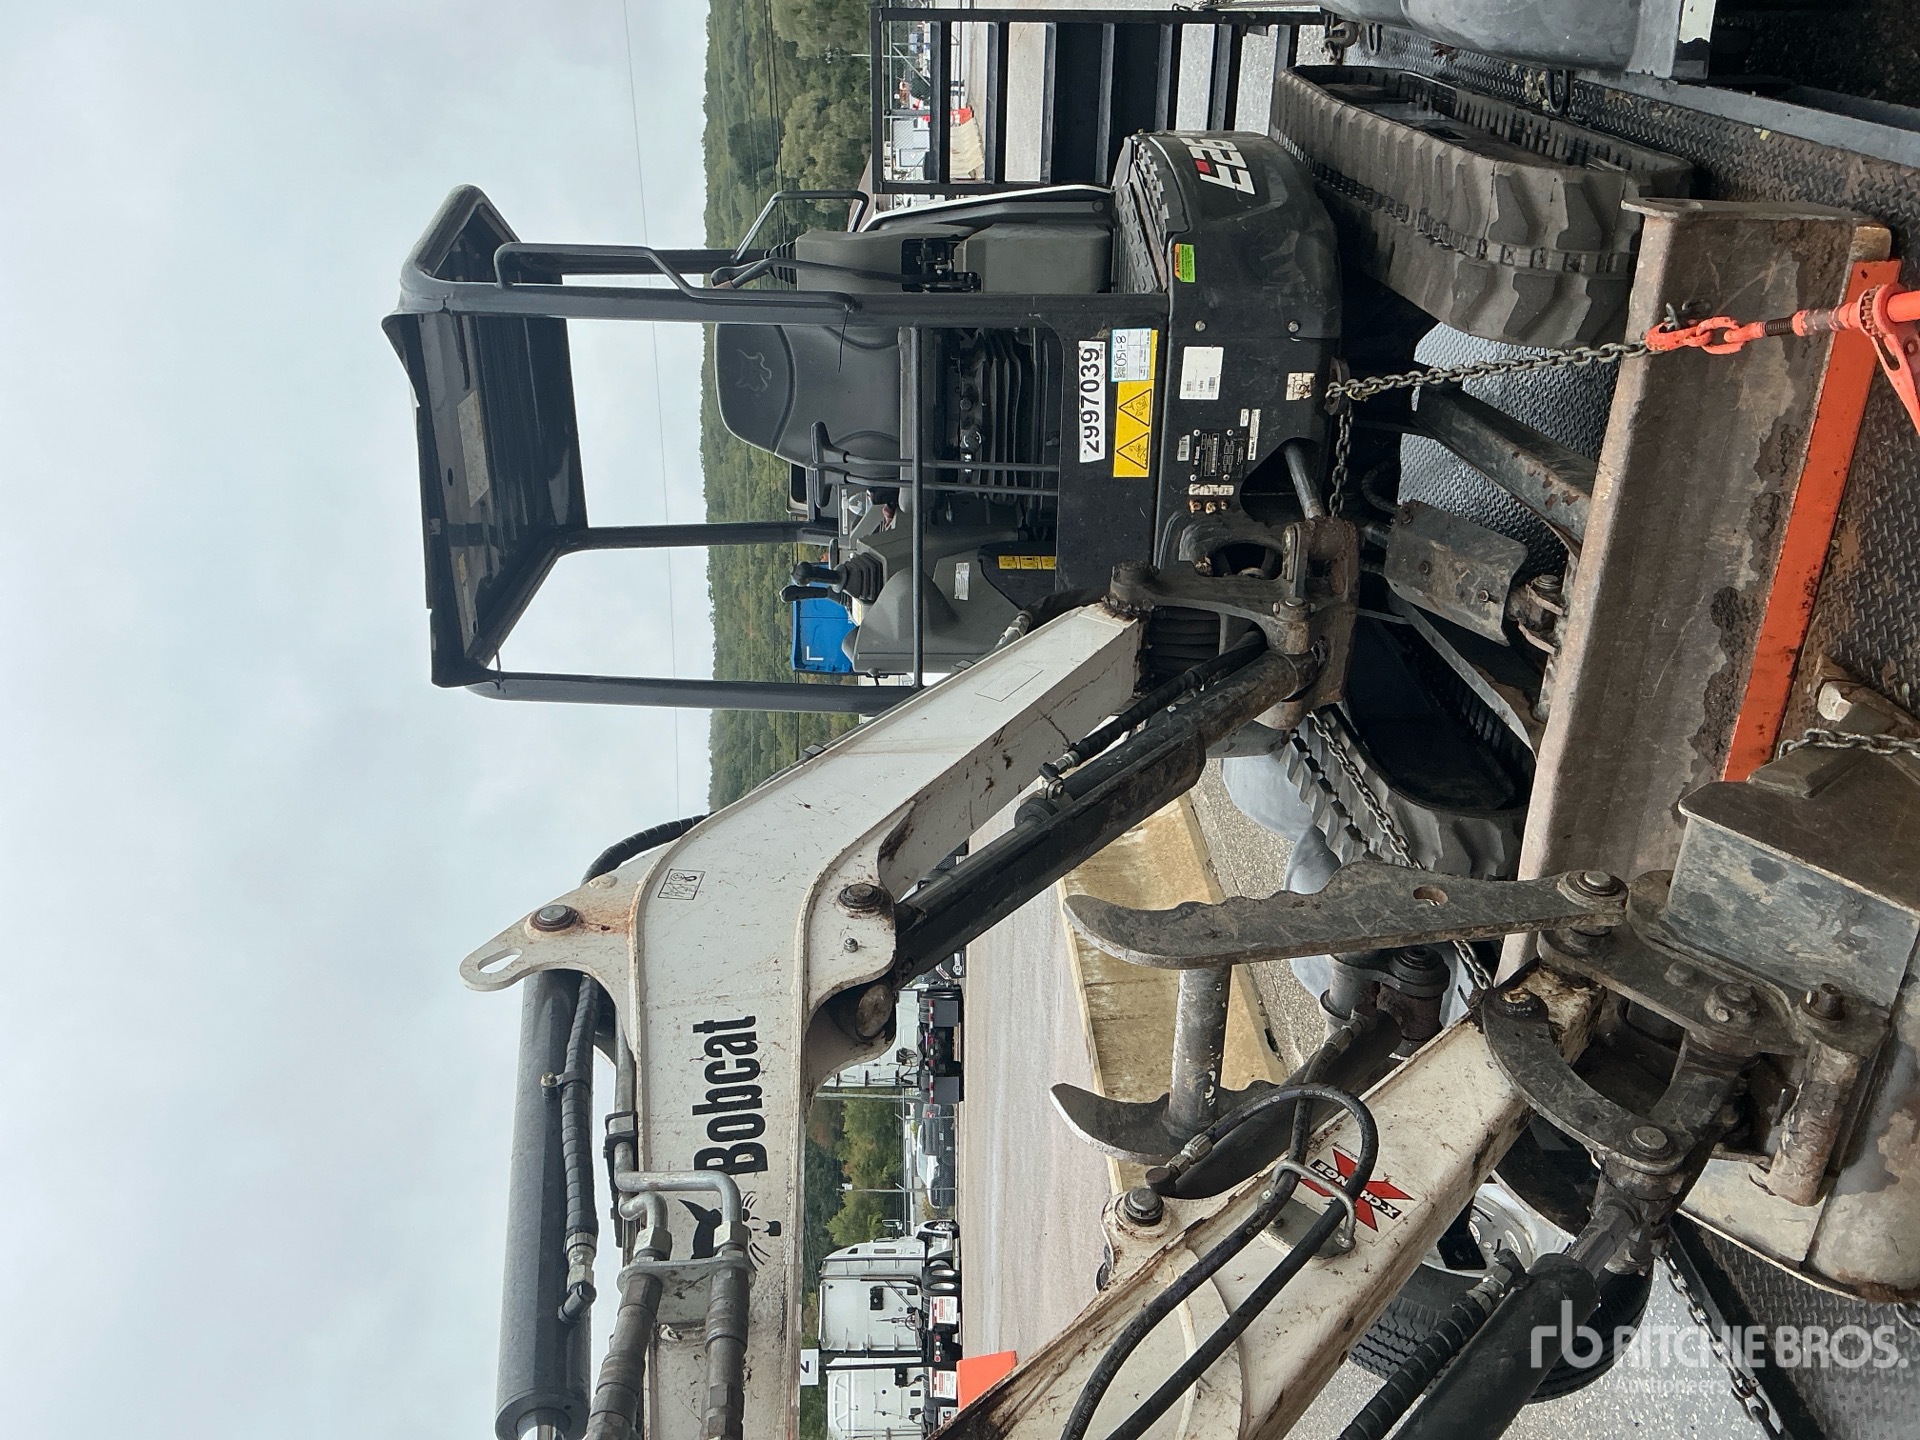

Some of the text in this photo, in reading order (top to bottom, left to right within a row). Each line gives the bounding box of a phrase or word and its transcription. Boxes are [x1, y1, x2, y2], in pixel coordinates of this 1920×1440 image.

[1080, 348, 1100, 453] 2997039
[692, 1016, 768, 1175] Bobcat
[1314, 1161, 1399, 1218] X-CHNGE
